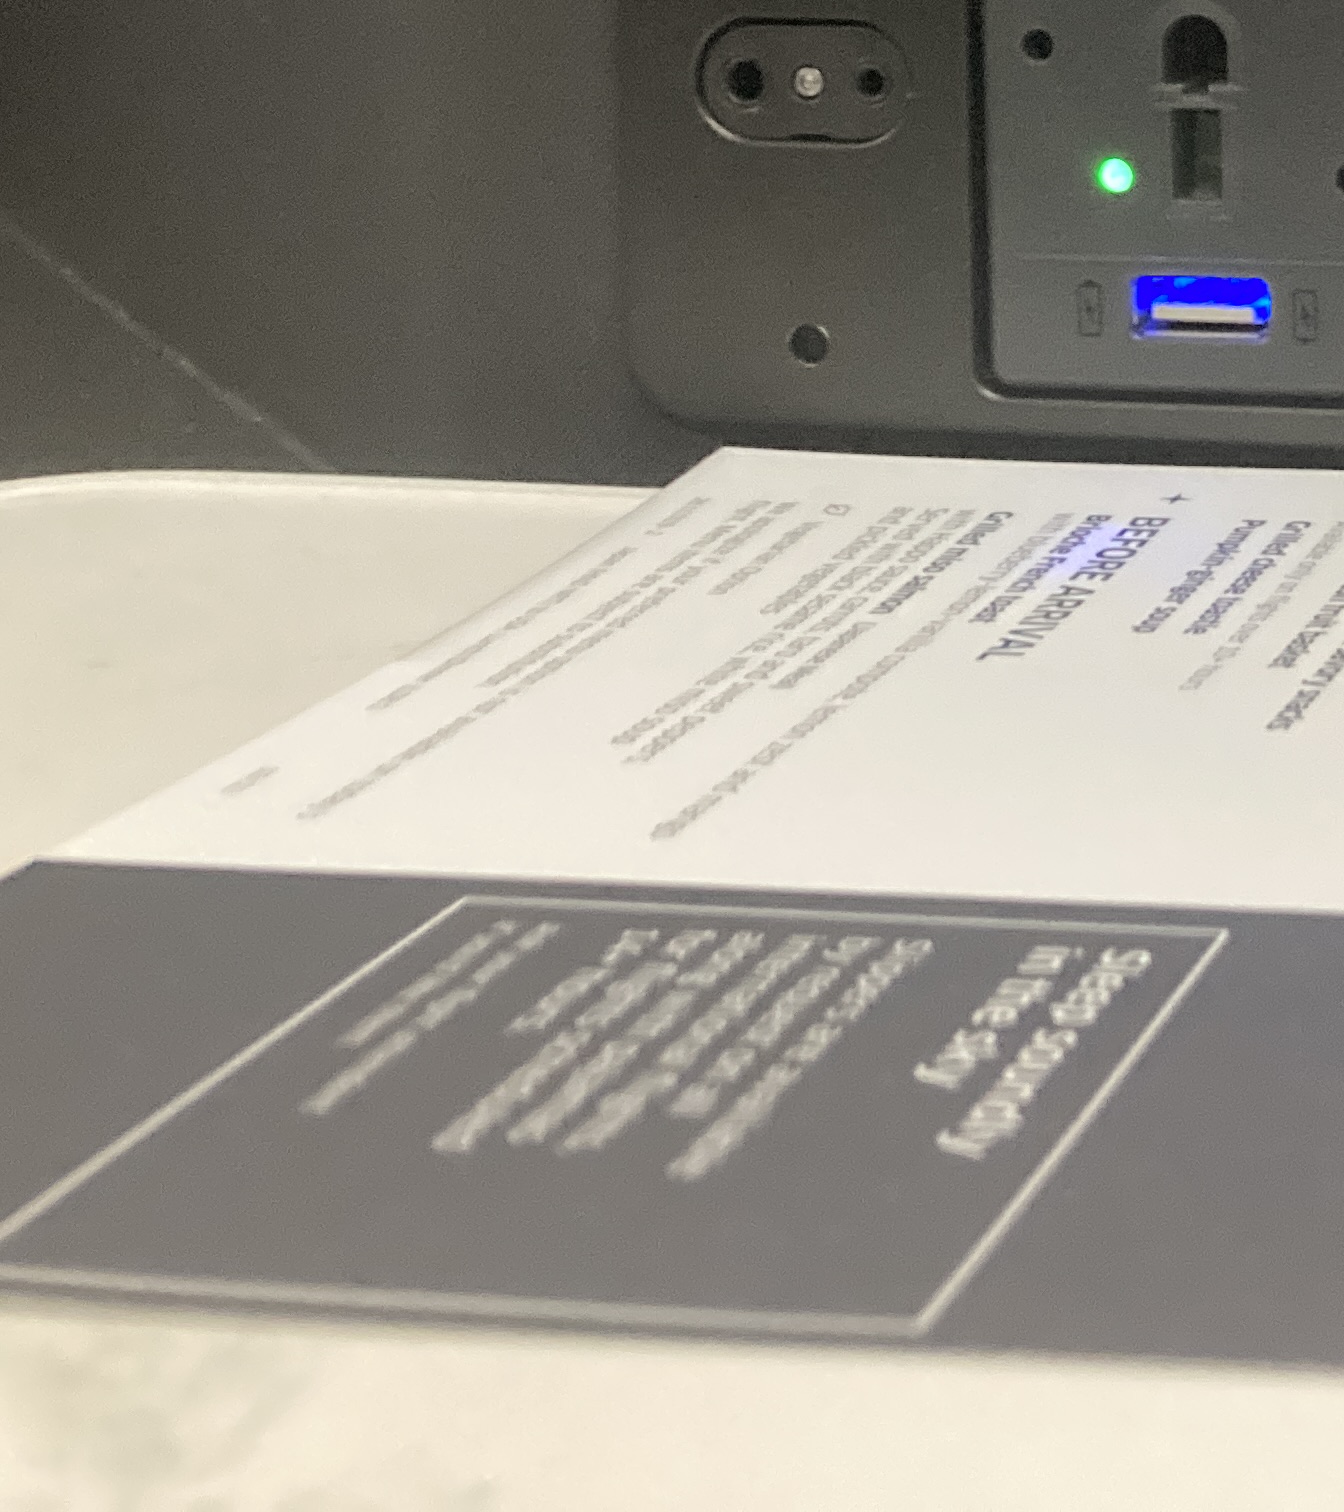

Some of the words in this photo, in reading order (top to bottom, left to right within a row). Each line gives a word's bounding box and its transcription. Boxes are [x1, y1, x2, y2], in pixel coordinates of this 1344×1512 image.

[877, 506, 914, 524] and
[892, 507, 950, 540] Served
[941, 509, 976, 530] with
[956, 511, 1014, 545] Grilled
[1038, 512, 1074, 534] with
[831, 526, 888, 560] pickled
[898, 532, 952, 563] Happo
[1049, 514, 1112, 554] Brioche
[1070, 516, 1170, 581] BEFORE
[1261, 520, 1312, 555] Grilled
[864, 542, 902, 564] with
[922, 546, 969, 573] miso
[1166, 518, 1266, 604] Pumpkin-ginger
[760, 562, 841, 615] vegetables
[827, 565, 877, 591] black
[856, 564, 910, 594] sauce,
[1006, 556, 1067, 593] French
[1224, 557, 1276, 594] cheese
[773, 593, 837, 630] sesame
[870, 574, 934, 615] salmon
[895, 535, 1051, 653] blueberry-lemon-vanilla
[968, 595, 1022, 624] toast
[977, 584, 1094, 661] ARRIVAL
[1131, 606, 1178, 634] soup
[1183, 596, 1241, 635] toastie
[1268, 630, 1326, 669] basket
[743, 659, 785, 680] and
[699, 681, 755, 714] sweet
[1266, 689, 1321, 731] snacks
[1018, 945, 1084, 975] in
[972, 978, 1051, 1028] the
[1051, 948, 1151, 1027] Sleep
[784, 1023, 842, 1063] are
[914, 1029, 998, 1089] sky
[937, 1029, 1077, 1158] soundly
